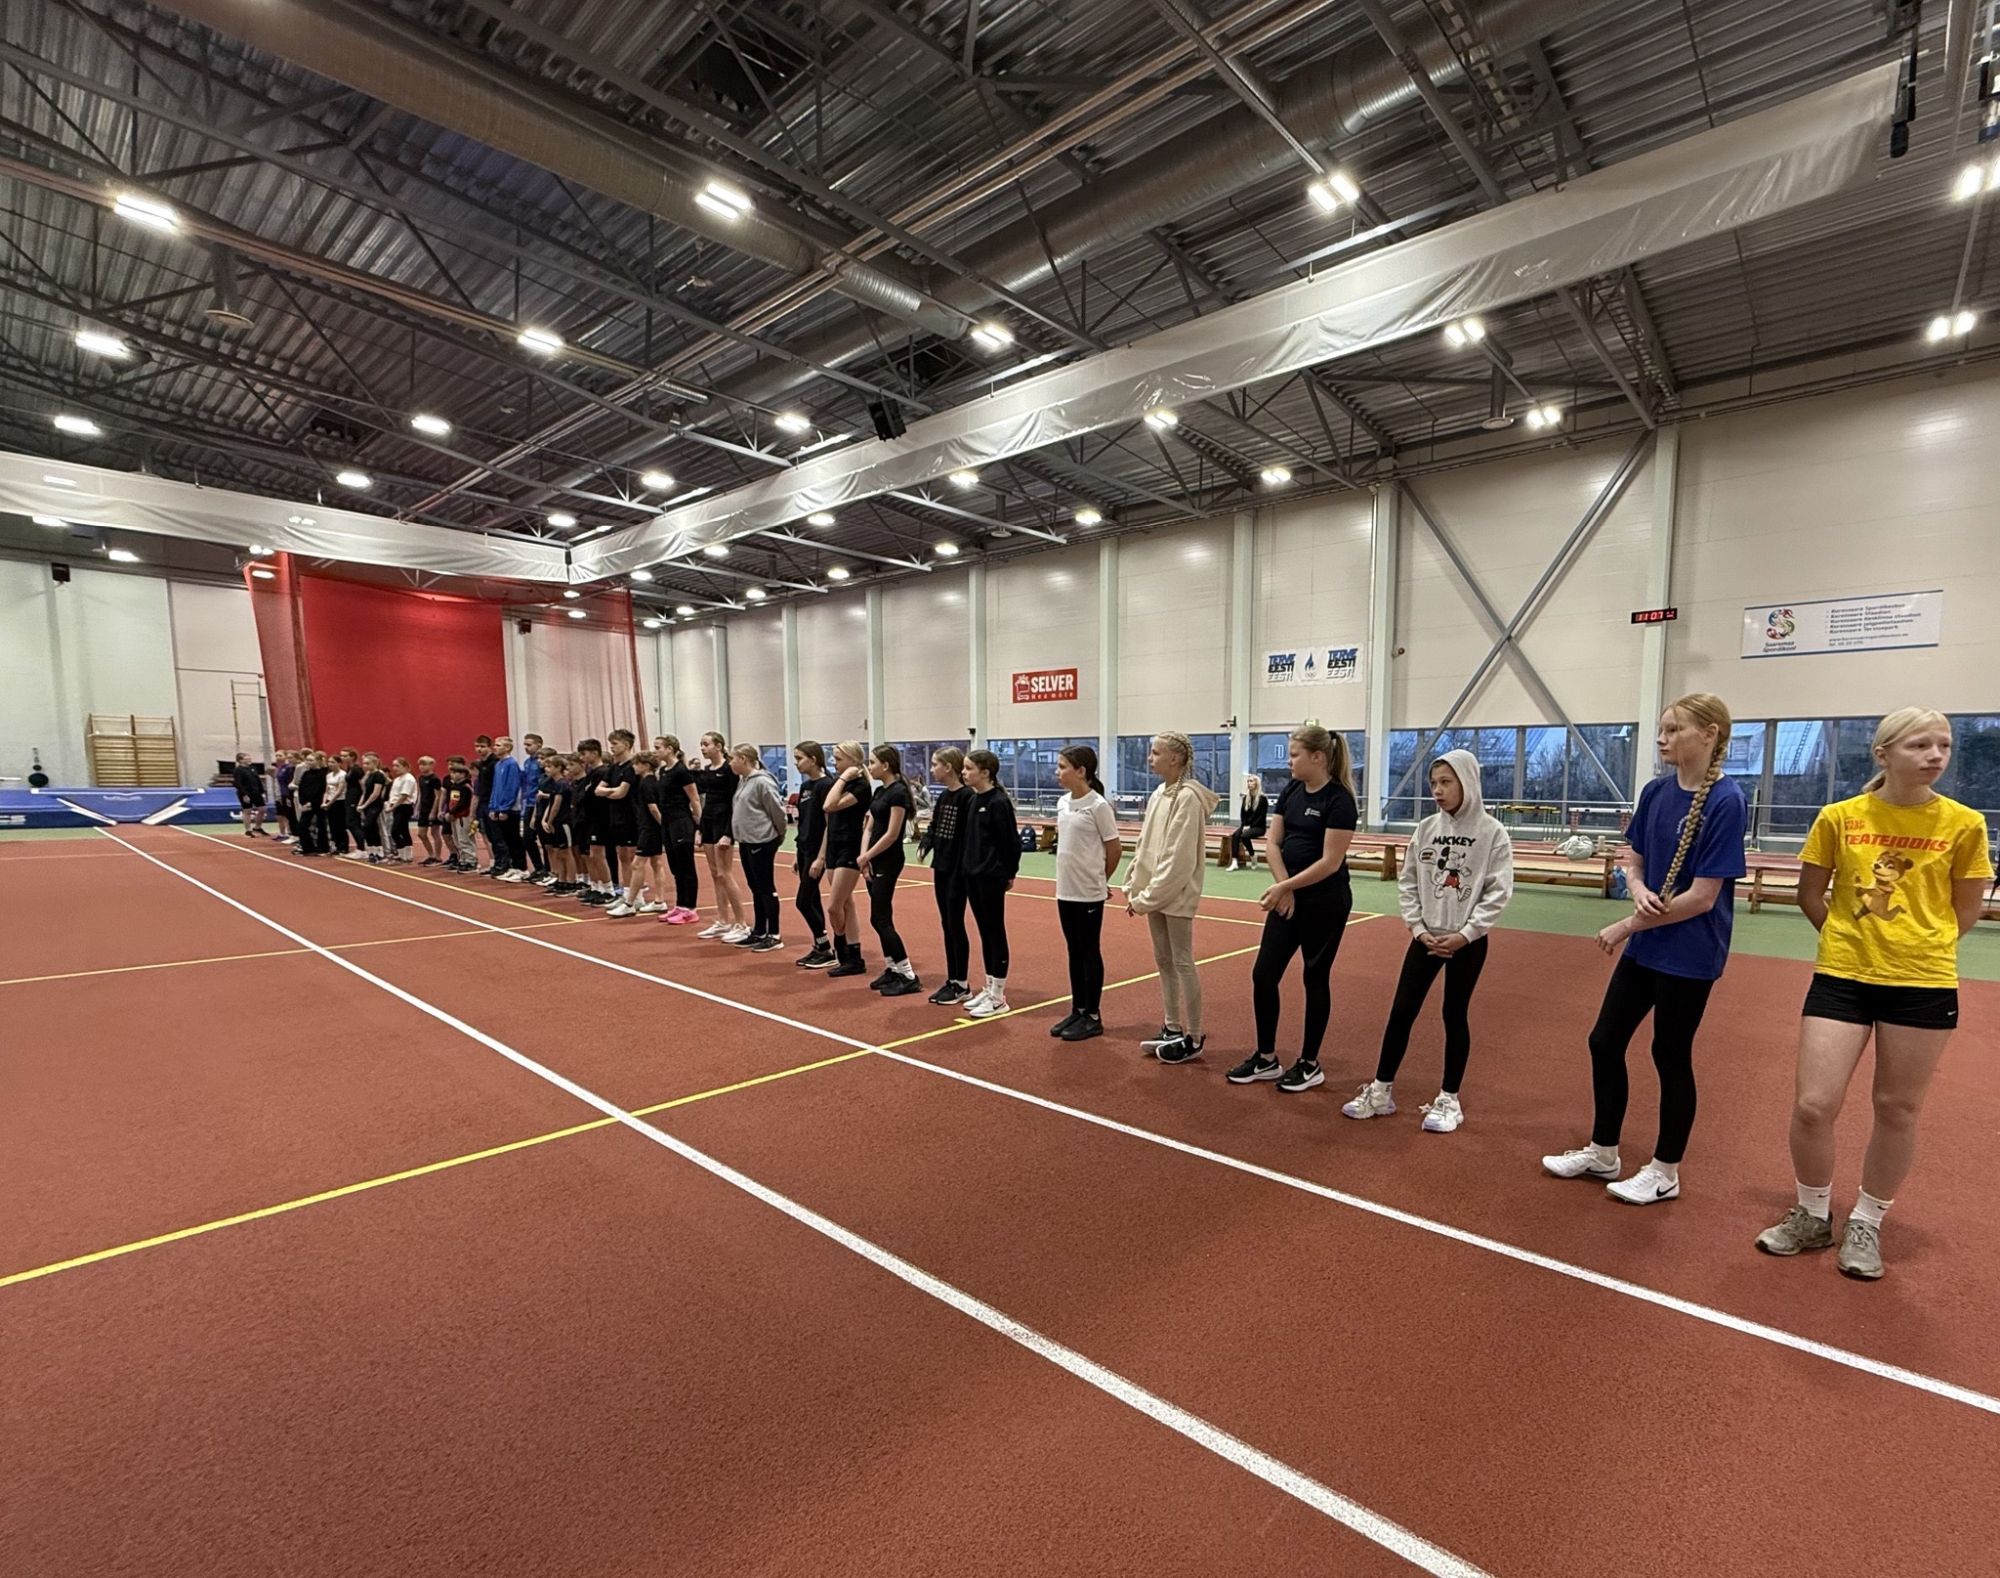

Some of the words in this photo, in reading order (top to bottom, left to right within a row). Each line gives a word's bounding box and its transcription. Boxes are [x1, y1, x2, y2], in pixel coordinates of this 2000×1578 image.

[1268, 654, 1296, 665] TERVE
[1328, 648, 1359, 660] TERVE
[1268, 661, 1295, 673] EESTI
[1327, 656, 1357, 669] EESTI
[1030, 674, 1074, 693] SELVER
[1432, 836, 1476, 847] MICKEY
